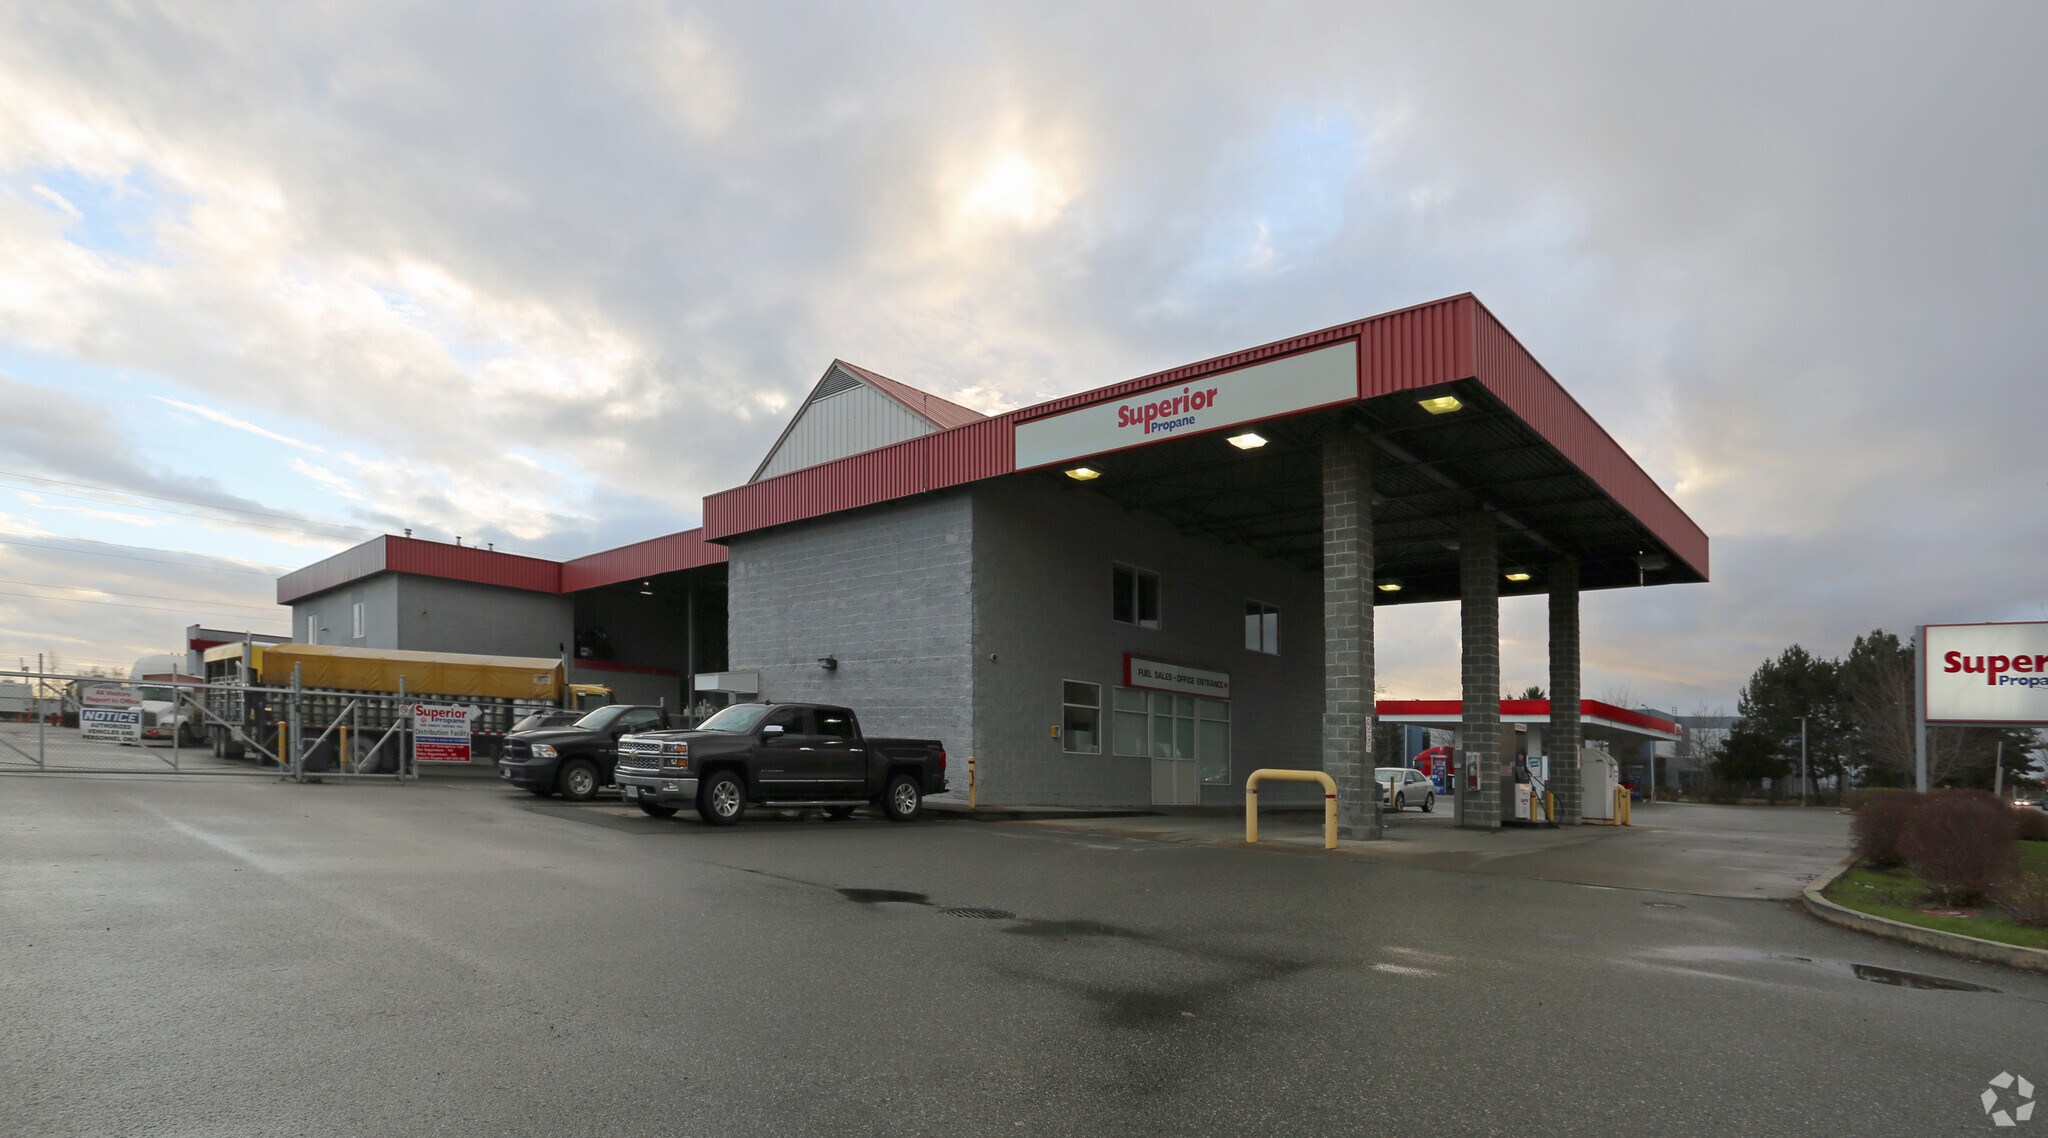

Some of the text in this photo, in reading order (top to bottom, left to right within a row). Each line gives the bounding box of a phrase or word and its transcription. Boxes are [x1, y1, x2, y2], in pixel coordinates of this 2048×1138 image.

[1118, 387, 1218, 434] Superior
[1151, 416, 1196, 432] Propane
[1138, 668, 1152, 678] FUEL
[1154, 671, 1172, 681] SALES
[1176, 674, 1195, 685] OFFICE
[1197, 678, 1224, 688] ENTRANCE
[84, 711, 138, 722] NOTICE
[416, 705, 467, 722] Superior
